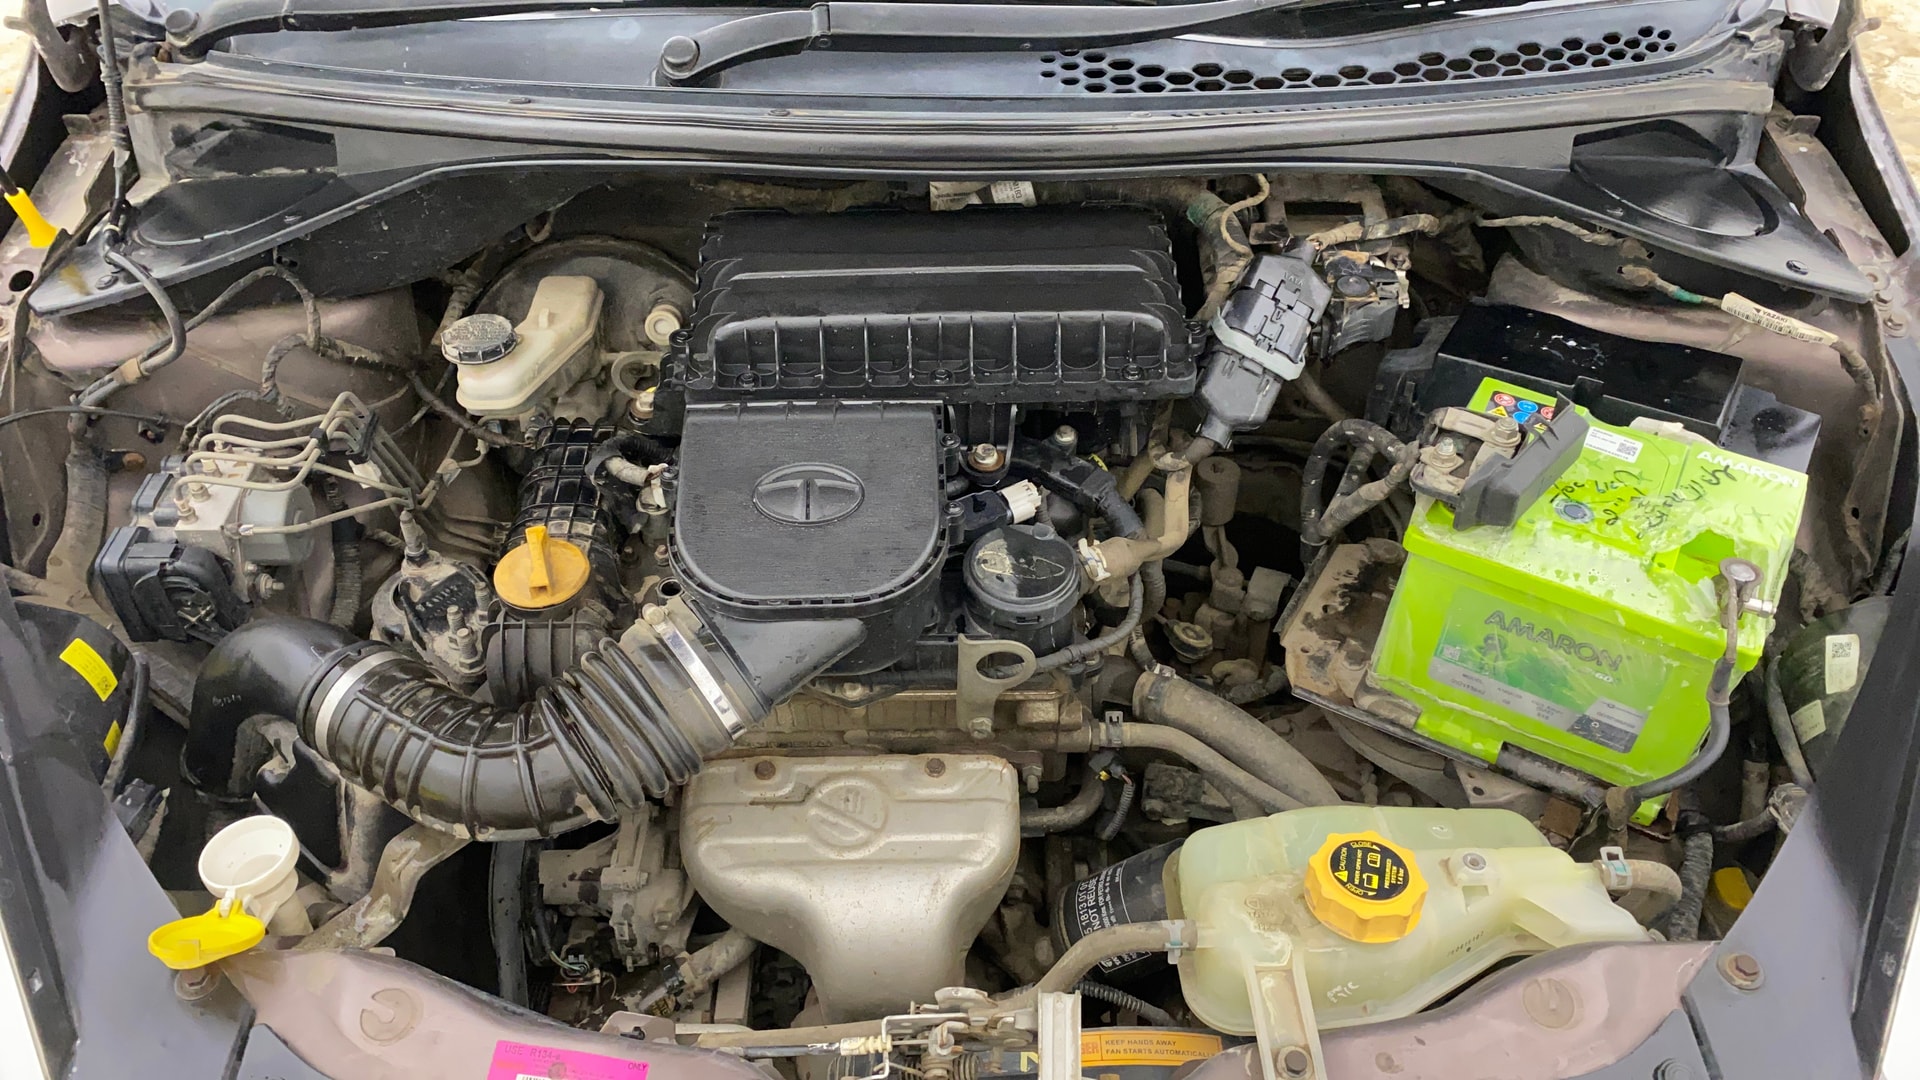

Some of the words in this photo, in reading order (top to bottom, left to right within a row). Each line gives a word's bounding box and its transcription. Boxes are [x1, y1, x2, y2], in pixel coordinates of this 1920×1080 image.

[1762, 310, 1789, 323] YAZAKI
[1696, 451, 1799, 487] AMARON
[1484, 609, 1624, 672] AMARON
[1339, 847, 1347, 870] CAUTION
[1078, 891, 1087, 902] 01
[1087, 876, 1099, 907] REUSE
[1346, 883, 1363, 895] OPEN
[1078, 902, 1090, 926] 1813
[1088, 908, 1102, 930] NOT
[504, 1044, 525, 1056] USE
[627, 1062, 649, 1072] ONLY
